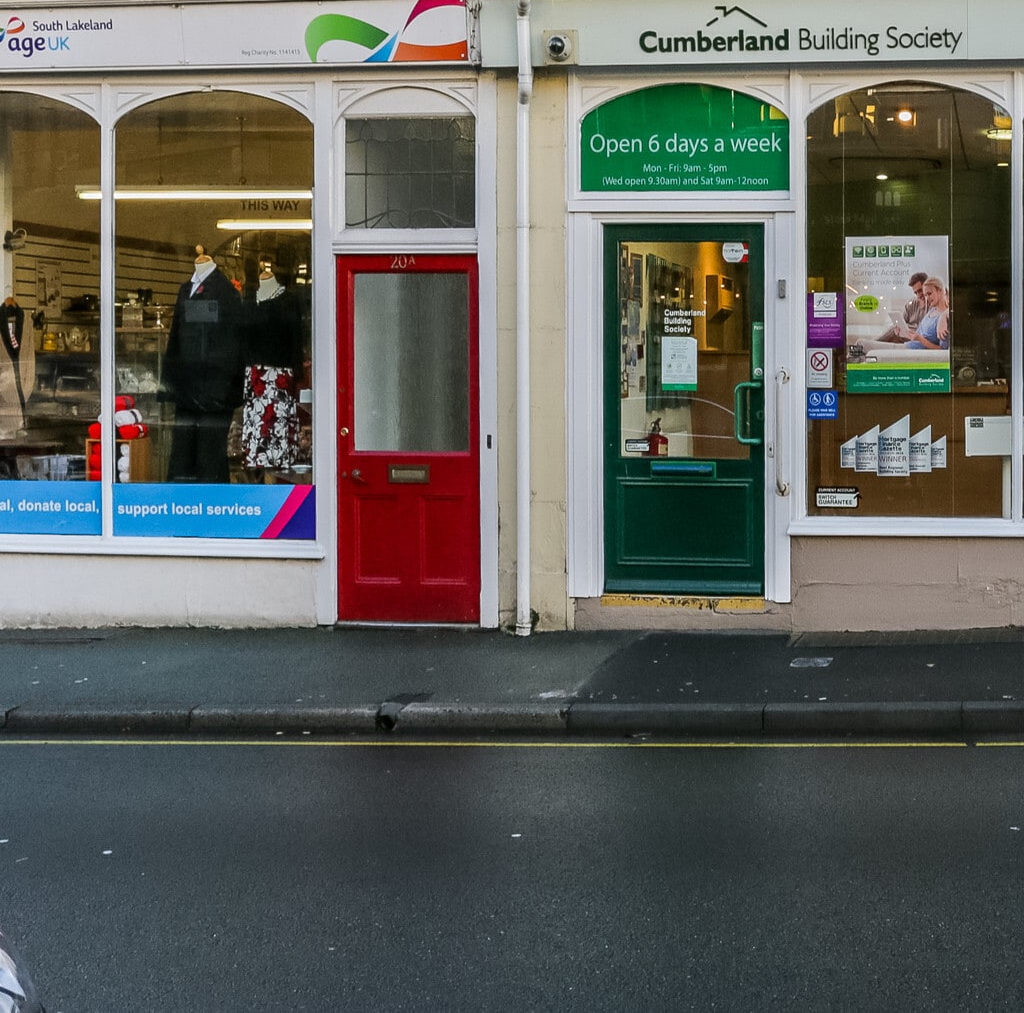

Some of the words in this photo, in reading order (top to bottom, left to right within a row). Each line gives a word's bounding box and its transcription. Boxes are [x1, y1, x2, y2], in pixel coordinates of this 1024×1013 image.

[32, 19, 63, 32] South
[66, 18, 113, 31] Lakeland
[639, 28, 790, 53] Cumberland
[798, 26, 880, 56] Building
[886, 24, 963, 53] Society
[589, 133, 643, 158] Open
[648, 134, 660, 153] 6
[665, 132, 709, 158] days
[714, 137, 725, 153] a
[731, 132, 782, 153] week
[643, 163, 662, 173] Mon
[669, 163, 682, 173] Fri:
[683, 164, 702, 173] 9am
[708, 163, 728, 175] 5pm
[602, 177, 623, 186] (Wed
[624, 178, 646, 187] open
[648, 177, 681, 186] 9.30am)
[682, 176, 699, 185] and
[700, 177, 714, 185] Sat
[715, 177, 769, 185] 9am-12noon
[240, 200, 269, 211] THIS
[272, 200, 300, 211] WAY
[852, 260, 895, 268] Cumberland
[897, 260, 911, 268] Plus
[852, 269, 879, 277] Current
[663, 308, 706, 317] Cumberland
[663, 317, 692, 326] Building
[663, 325, 692, 334] Society
[18, 499, 61, 512] donate
[65, 499, 100, 514] local,
[117, 503, 169, 517] support
[171, 502, 203, 515] local
[206, 503, 262, 516] services
